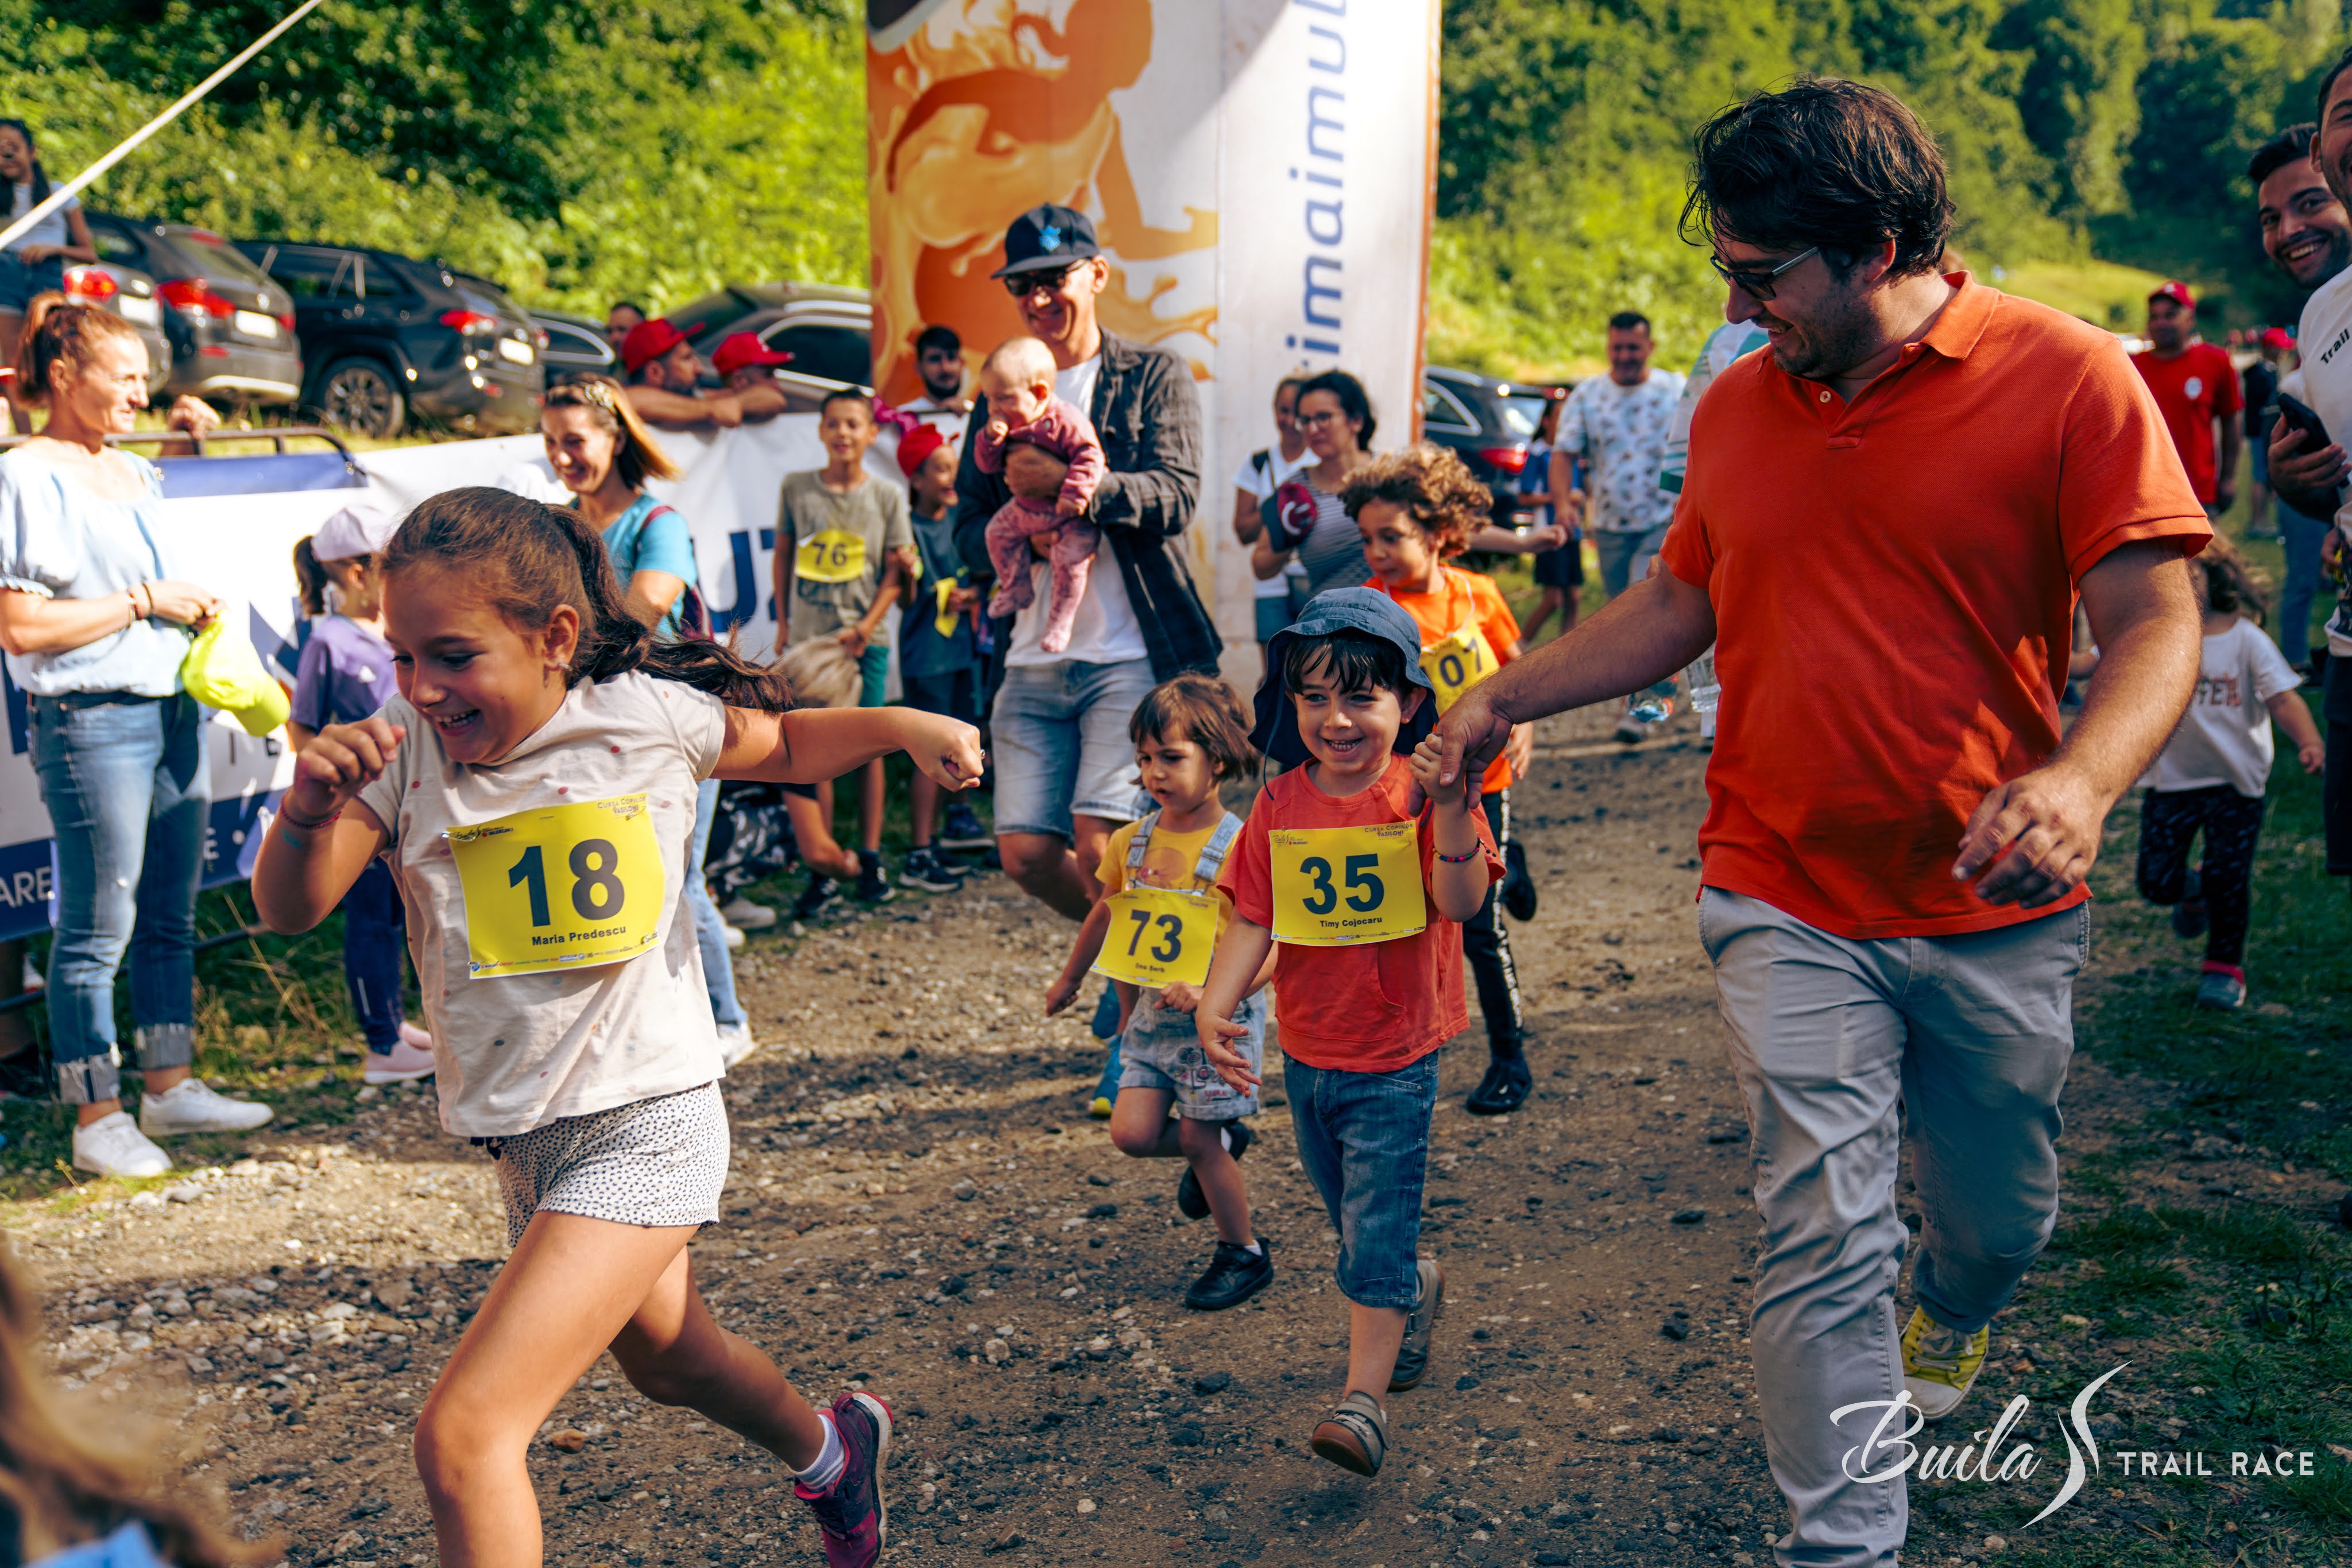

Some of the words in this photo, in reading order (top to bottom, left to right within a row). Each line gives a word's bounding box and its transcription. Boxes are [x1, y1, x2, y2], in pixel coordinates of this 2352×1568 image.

[2321, 328, 2350, 363] Trail
[812, 541, 847, 566] 76
[508, 838, 625, 927] 18
[1300, 853, 1384, 915] 35
[532, 935, 565, 946] Maria
[569, 926, 626, 942] Predescu
[1127, 909, 1182, 962] 73
[1320, 920, 1339, 928] Timy
[1342, 917, 1383, 927] Cojocaru
